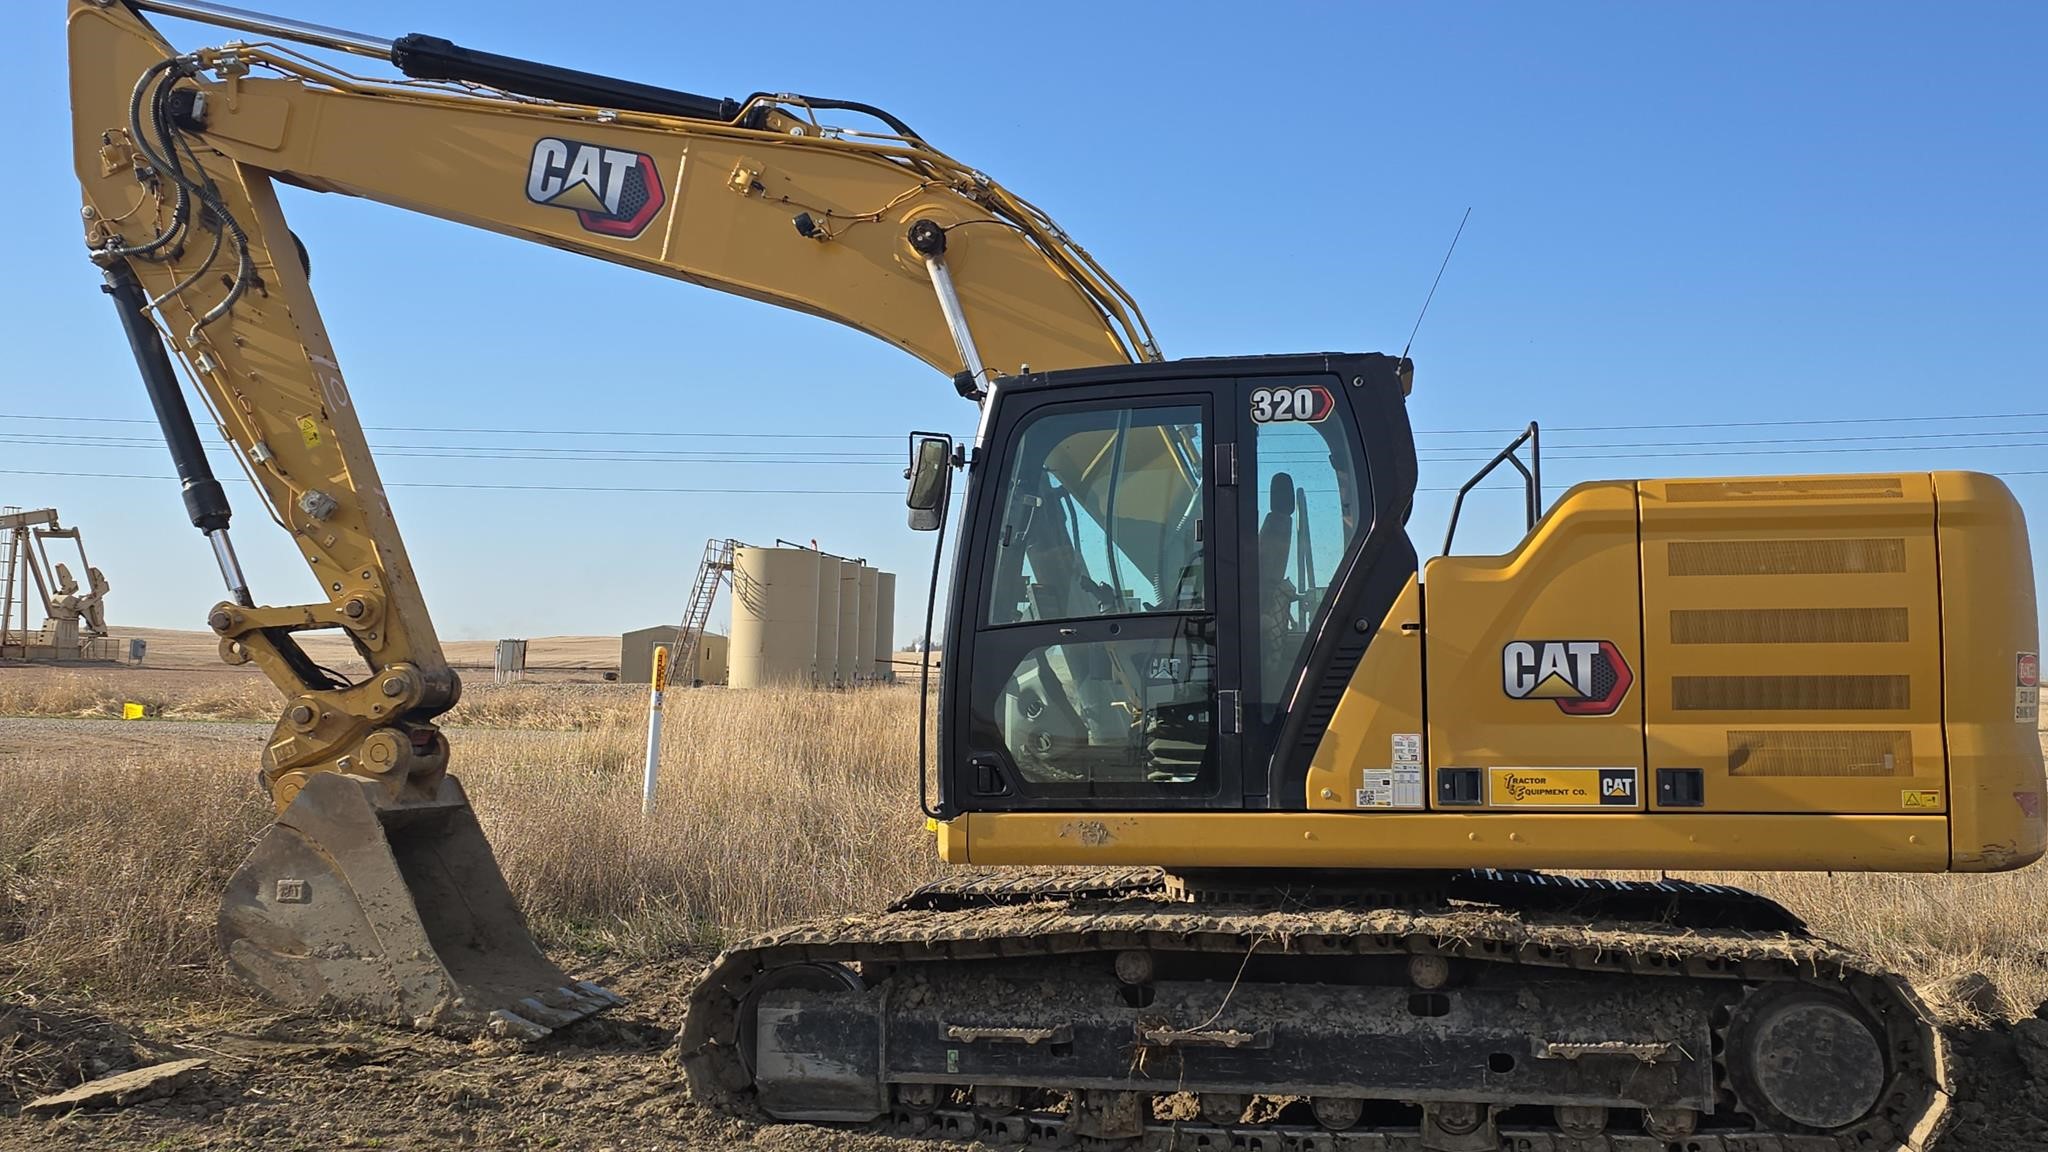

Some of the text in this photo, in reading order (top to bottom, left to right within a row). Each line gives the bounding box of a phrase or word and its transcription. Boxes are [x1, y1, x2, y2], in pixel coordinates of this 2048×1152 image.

[528, 138, 638, 215] CAT
[1253, 389, 1313, 421] 320
[1504, 642, 1599, 697] CAT
[1504, 773, 1546, 789] TRACTOR
[1515, 786, 1569, 800] EQUIPMENT
[1602, 778, 1632, 796] CAT
